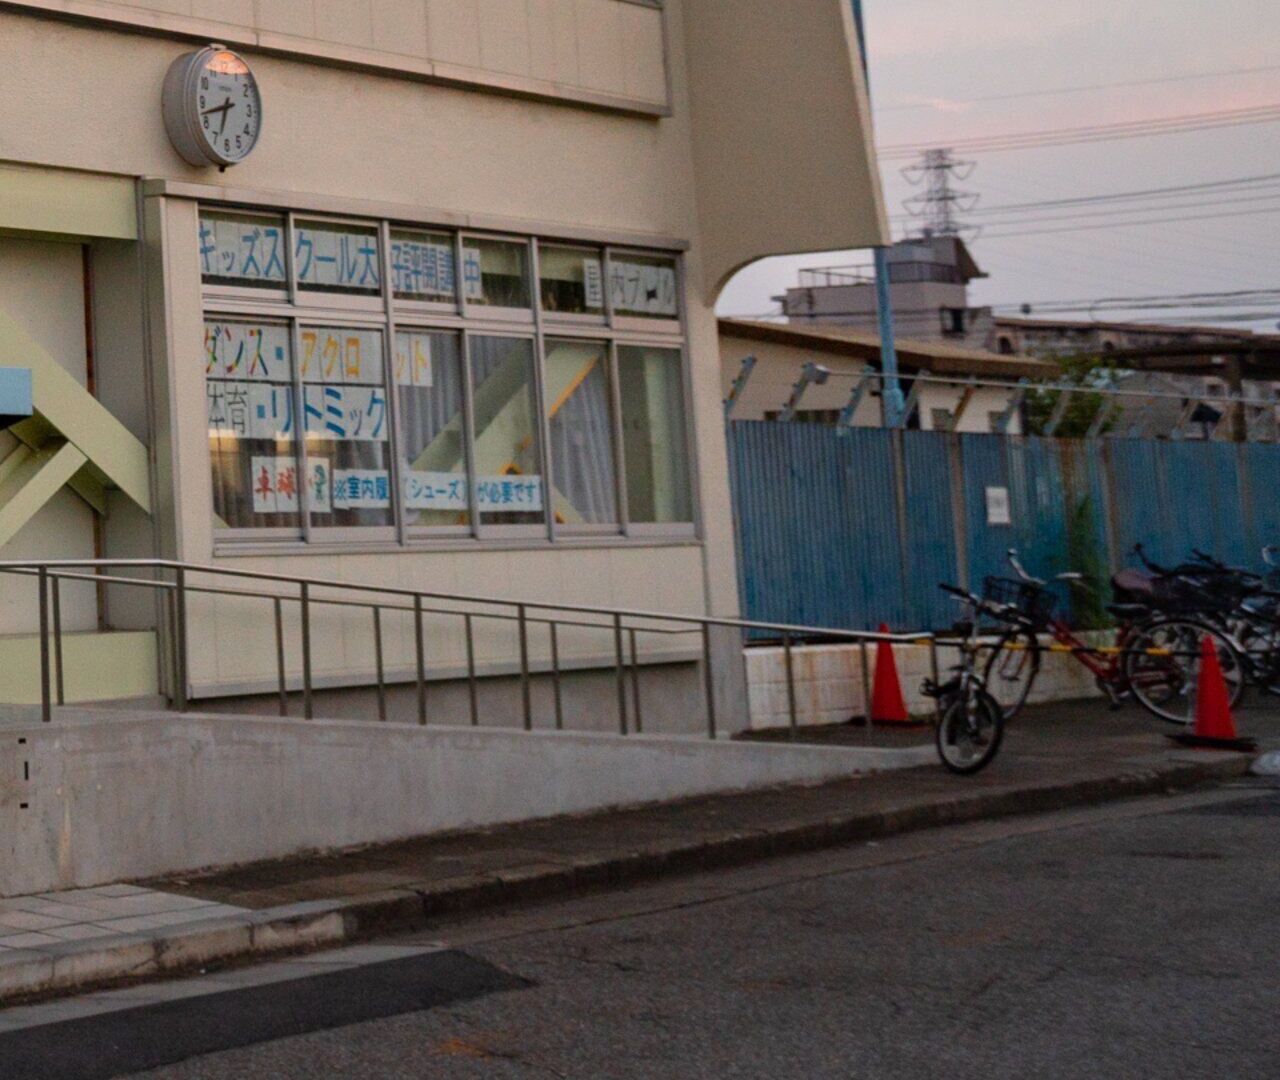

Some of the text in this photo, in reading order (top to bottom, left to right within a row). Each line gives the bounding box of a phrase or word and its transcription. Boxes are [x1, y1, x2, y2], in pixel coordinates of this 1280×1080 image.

[243, 84, 248, 98] 2
[199, 95, 205, 109] 9
[246, 104, 252, 118] 3
[243, 123, 250, 136] 4
[212, 131, 218, 145] 7
[235, 135, 241, 149] 5
[224, 139, 230, 153] 6
